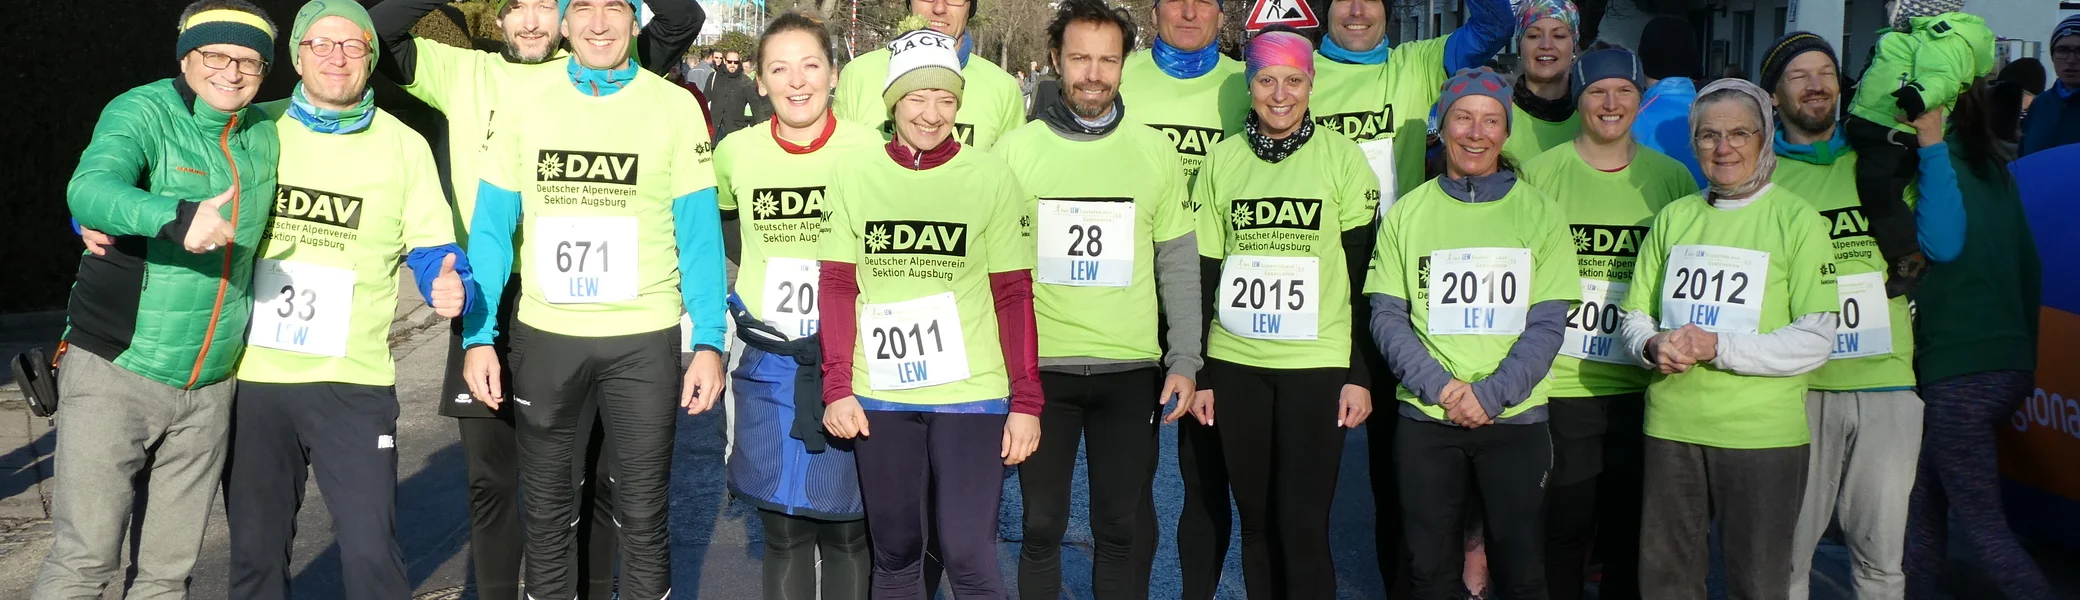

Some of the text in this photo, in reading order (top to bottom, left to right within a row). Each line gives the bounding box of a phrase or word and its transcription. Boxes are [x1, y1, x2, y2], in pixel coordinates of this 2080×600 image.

[1344, 107, 1390, 139] DAV
[1162, 127, 1222, 151] DAV
[565, 154, 636, 180] DAV
[537, 184, 637, 196] Deutscher Alpenverein
[544, 195, 627, 208] Sektion Augsburg
[287, 189, 360, 224] DAV
[781, 189, 826, 216] DA
[1256, 200, 1320, 226] DAV
[267, 220, 358, 241] utscher Alpenverein
[754, 221, 797, 231] Deutscher
[763, 233, 795, 242] Sektion
[1235, 230, 1319, 241] eutscher Alpenverein
[263, 229, 345, 251] Sektion Augsburg
[893, 224, 964, 252] DAV
[1067, 224, 1103, 257] 28
[1239, 241, 1311, 253] Sektion Augsburg
[556, 240, 608, 273] 671
[865, 256, 965, 268] Deutscher Alpenverein
[1607, 258, 1636, 269] Alpenv
[873, 267, 953, 281] Sektion Augsburg
[1071, 260, 1099, 281] LEW
[1579, 268, 1633, 280] ektion Augsb
[569, 277, 599, 297] LEW
[1231, 277, 1304, 311] 2015
[1441, 270, 1516, 304] 2010
[1672, 267, 1748, 305] 2012
[277, 285, 317, 321] 33
[776, 281, 814, 315] 20
[1252, 313, 1281, 333] LEW
[1565, 301, 1621, 335] 200
[1689, 304, 1720, 326] LEW
[1836, 298, 1860, 329] 0
[800, 319, 819, 337] LE
[872, 319, 943, 360] 2011
[1582, 334, 1612, 357] LEW
[897, 360, 928, 384] LEW
